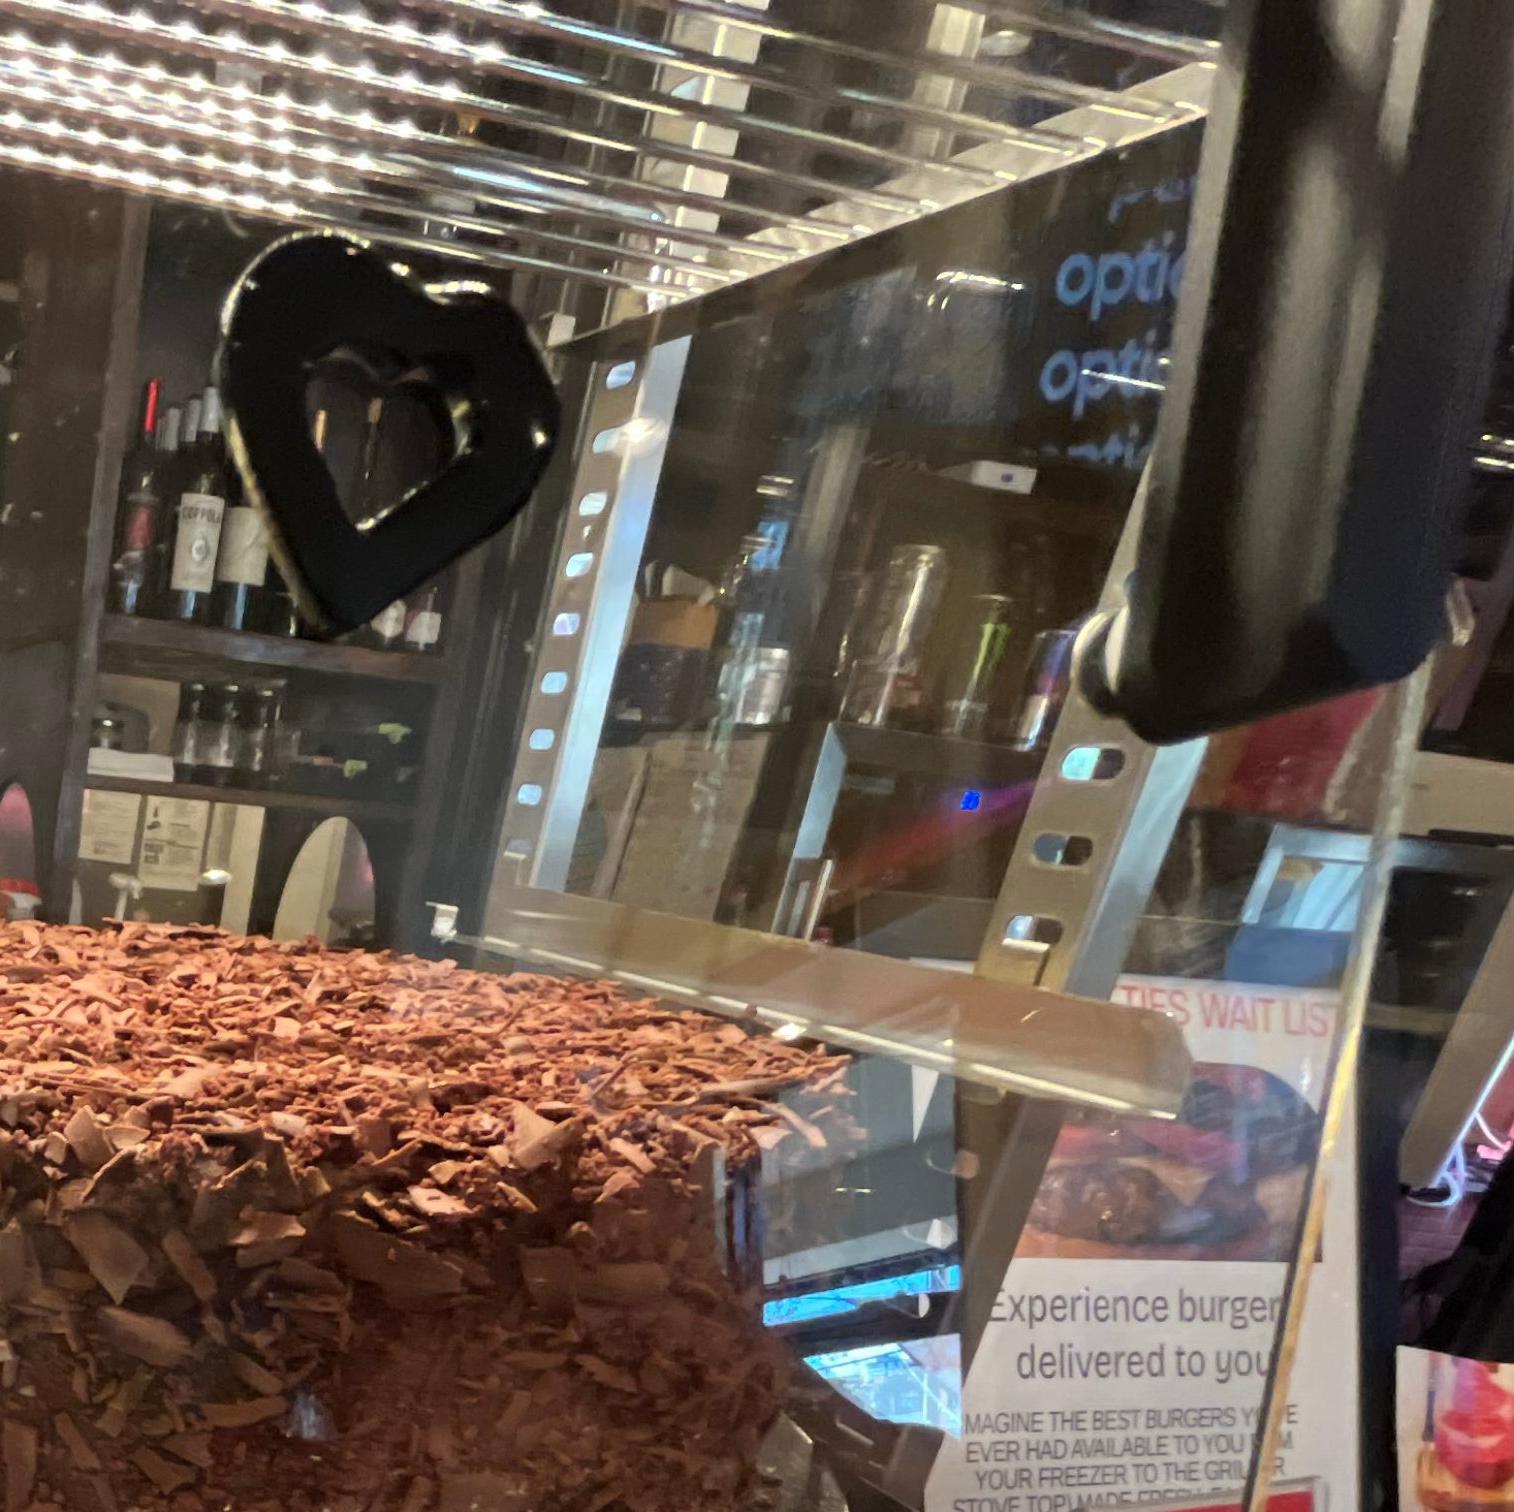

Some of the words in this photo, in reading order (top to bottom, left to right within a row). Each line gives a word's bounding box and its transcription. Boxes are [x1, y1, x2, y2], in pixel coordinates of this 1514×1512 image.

[1199, 991, 1275, 1034] WAIT
[989, 1287, 1169, 1330] Experience
[1016, 1343, 1165, 1379] delivered
[1175, 1344, 1206, 1378] to
[965, 1411, 1044, 1435] MAGINE
[1049, 1410, 1088, 1432] THE
[1092, 1409, 1141, 1431] BEST
[1145, 1407, 1237, 1429] BURGERS
[966, 1441, 1021, 1464] EVER
[1026, 1438, 1068, 1460] HAD
[1071, 1436, 1169, 1459] AVAILABLE
[1174, 1434, 1199, 1455] TO
[1203, 1433, 1245, 1454] YOU
[975, 1468, 1033, 1490] YOUR
[1038, 1464, 1128, 1487] FREEZER
[1132, 1463, 1158, 1484] TO
[1163, 1461, 1201, 1482] THE
